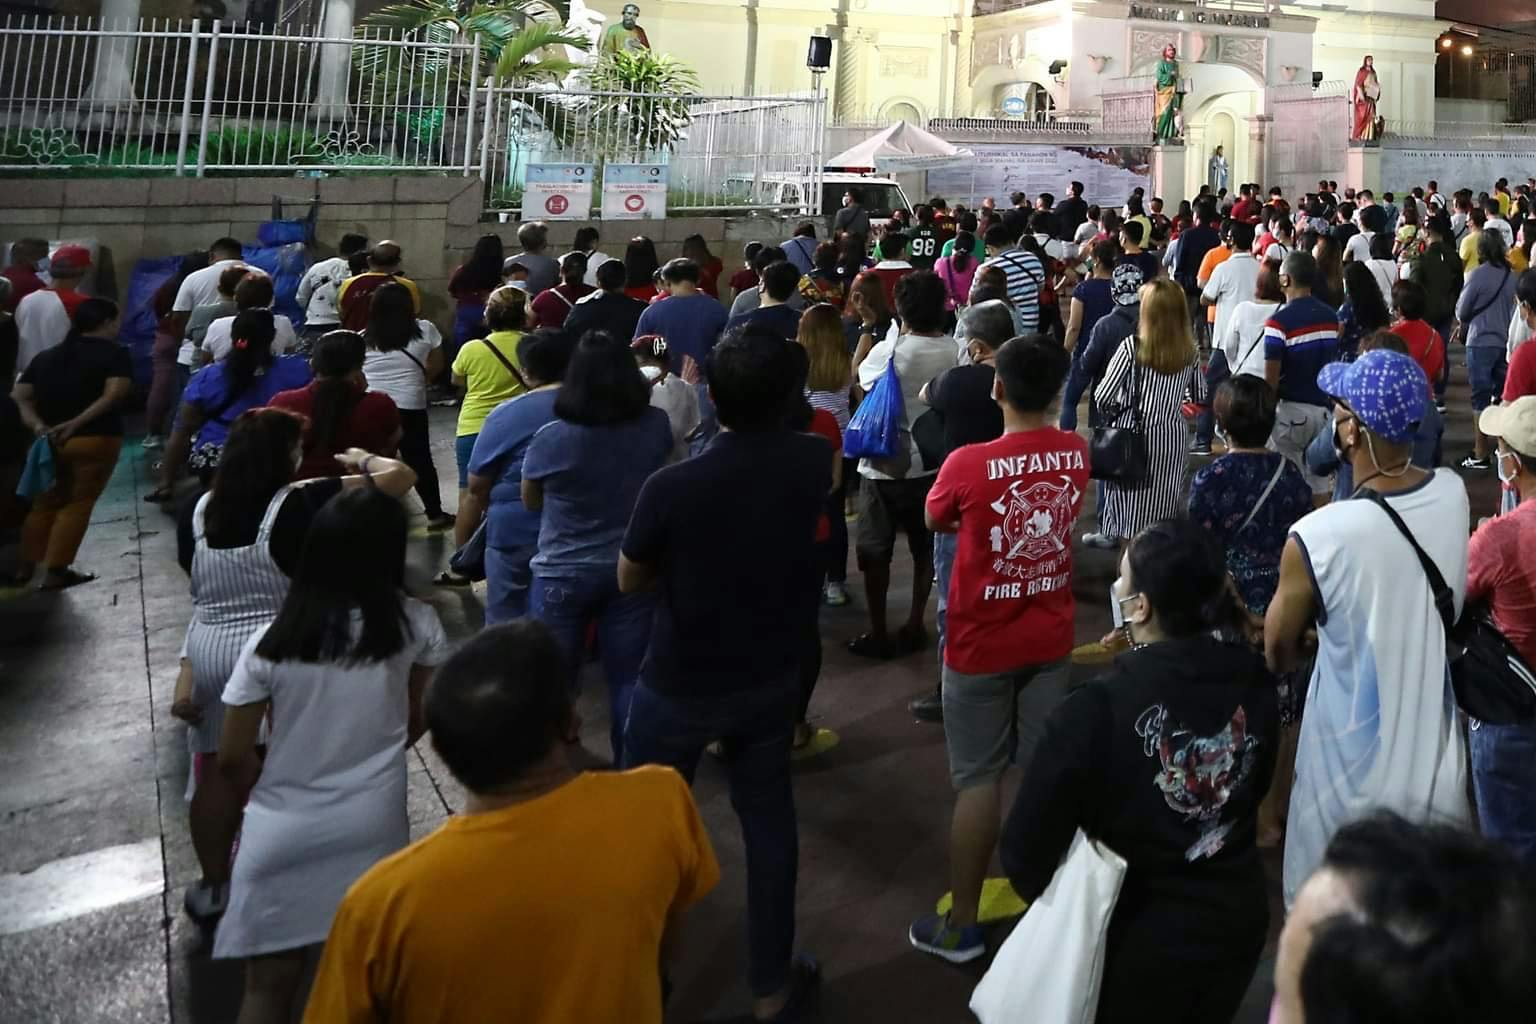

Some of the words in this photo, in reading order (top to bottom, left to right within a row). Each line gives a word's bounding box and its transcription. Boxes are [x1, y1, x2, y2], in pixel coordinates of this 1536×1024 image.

[911, 238, 936, 256] 98
[987, 451, 1084, 480] INFANTA
[984, 582, 1021, 601] FIRE
